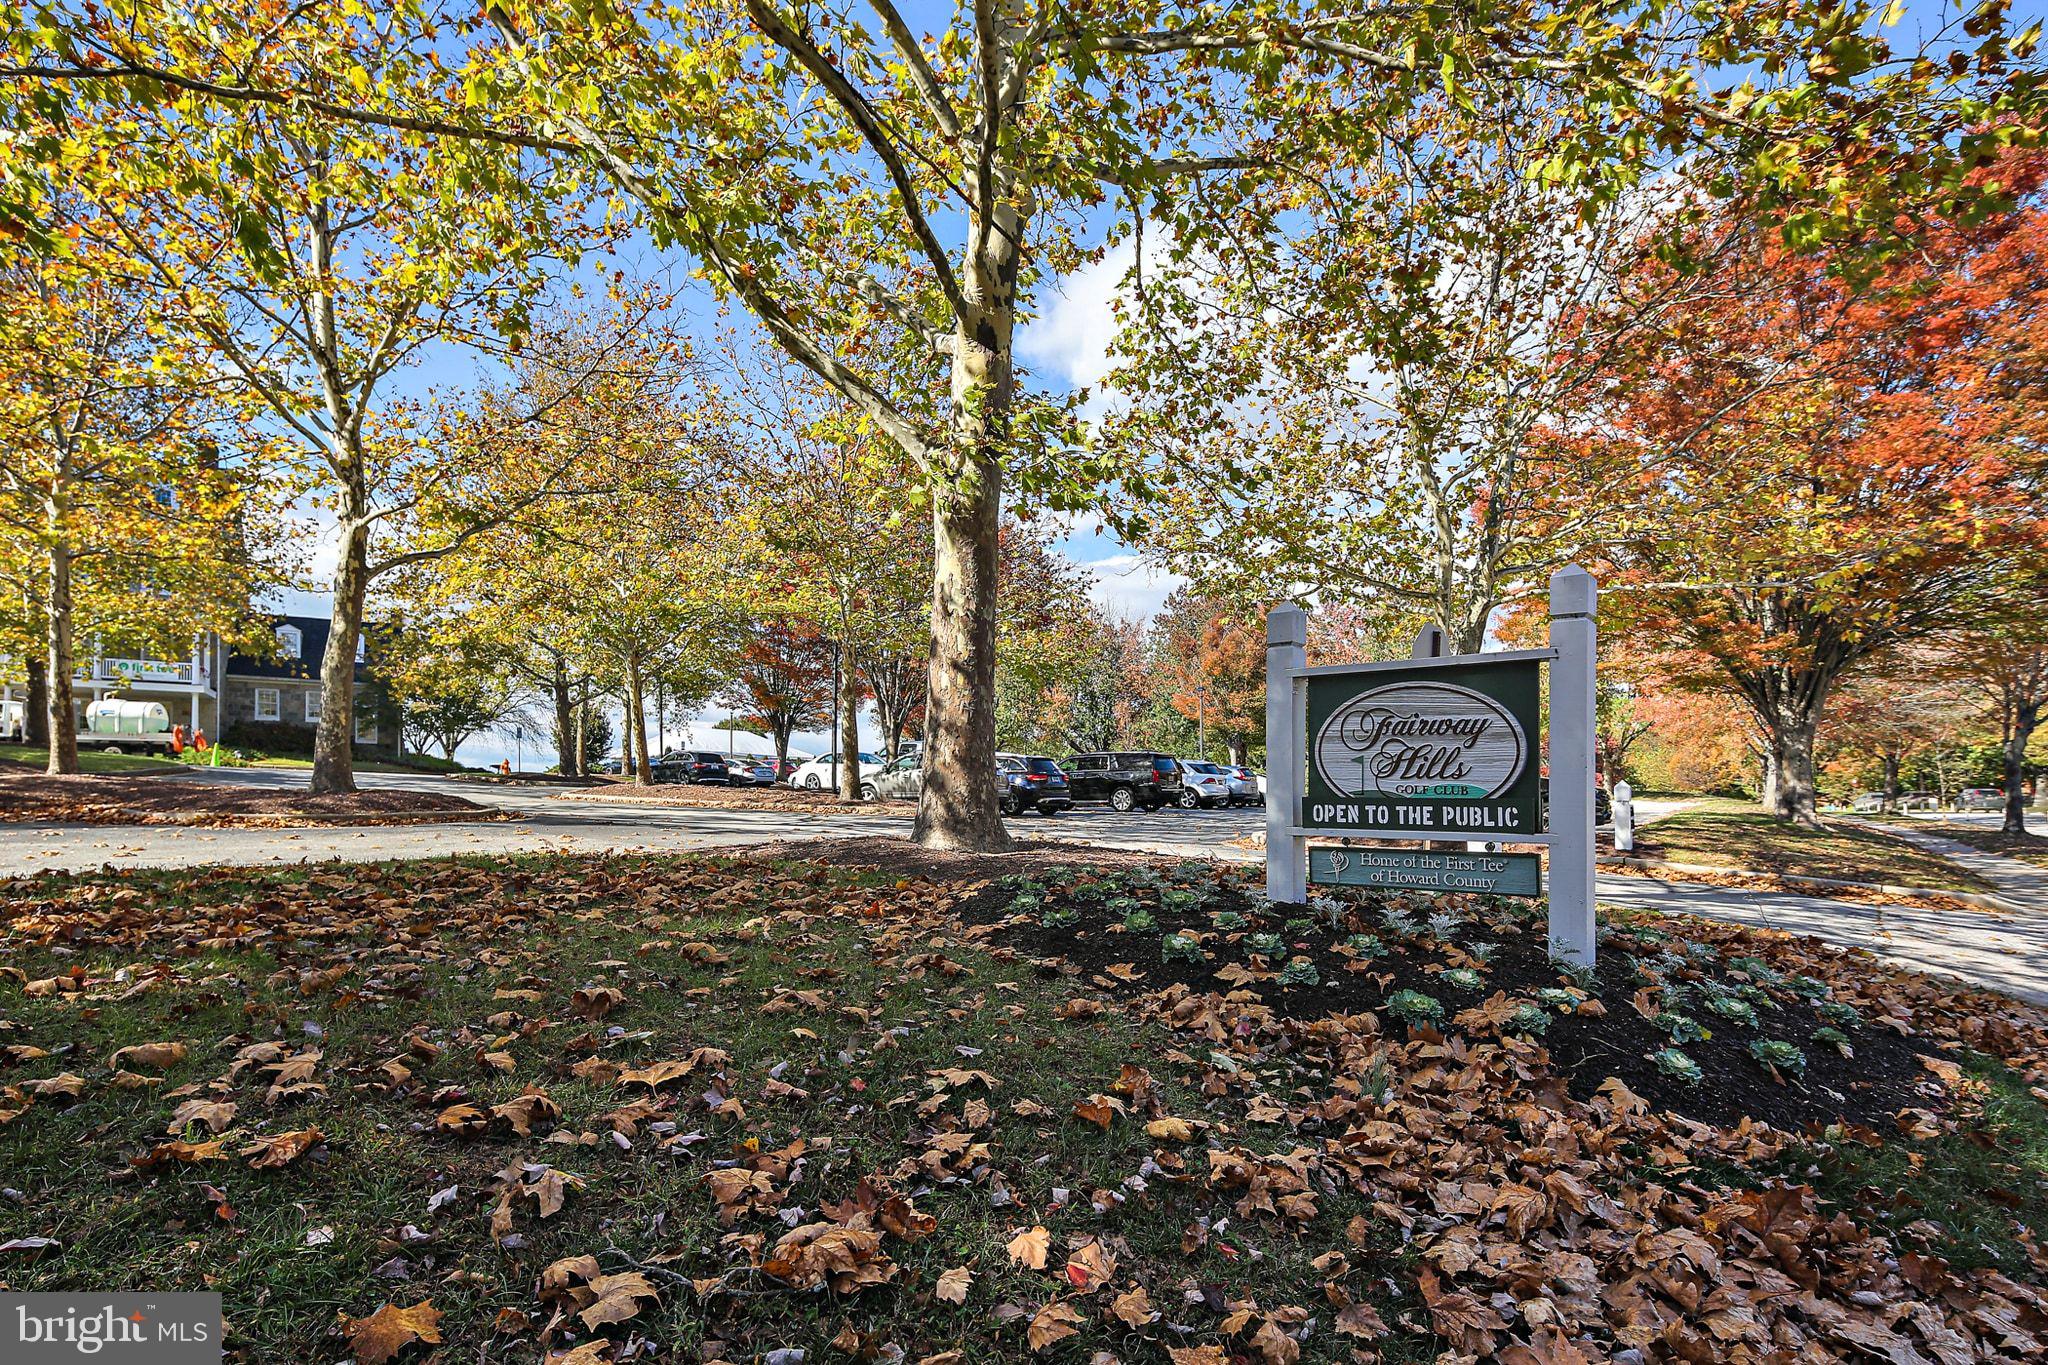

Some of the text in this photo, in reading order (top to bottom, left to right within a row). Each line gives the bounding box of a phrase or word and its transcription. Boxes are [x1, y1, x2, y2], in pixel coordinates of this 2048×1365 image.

[1341, 708, 1493, 751] Fairway
[1370, 738, 1472, 792] Hills
[1396, 784, 1469, 797] GOLF CLUB
[1312, 804, 1519, 827] OPEN TO THE PUBLIC
[1360, 852, 1505, 873] Home of the First Tee
[1370, 870, 1496, 893] of Howard County
